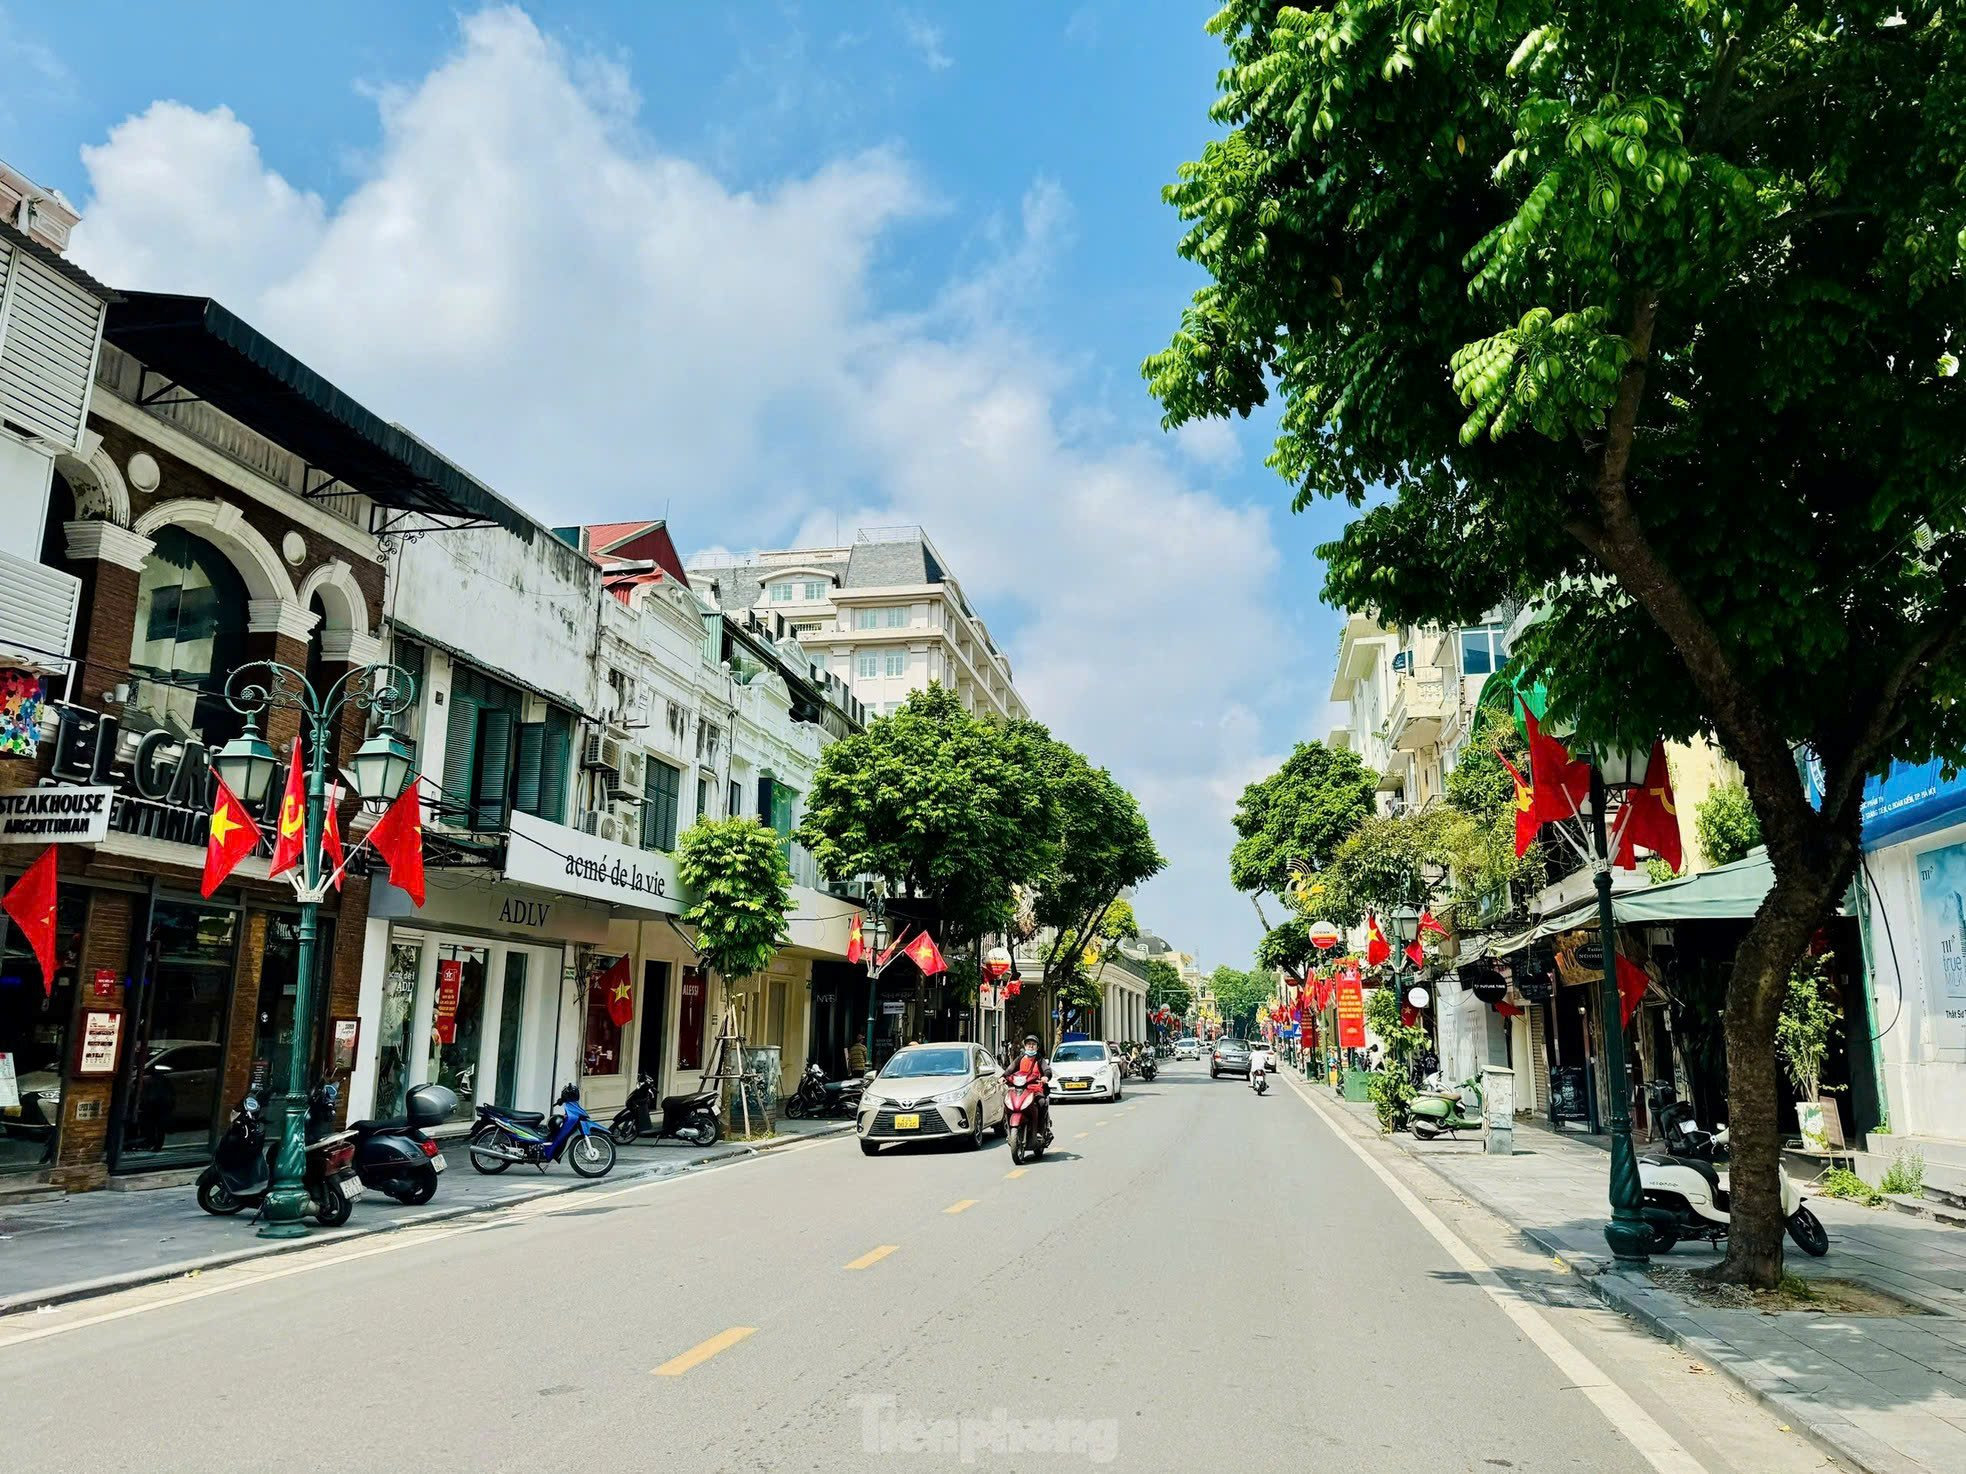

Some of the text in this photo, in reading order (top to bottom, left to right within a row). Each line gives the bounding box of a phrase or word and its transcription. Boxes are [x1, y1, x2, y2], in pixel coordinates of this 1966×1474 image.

[566, 855, 665, 897] acmé de la vie
[499, 897, 550, 927] ADLV
[682, 984, 699, 996] ALESSI
